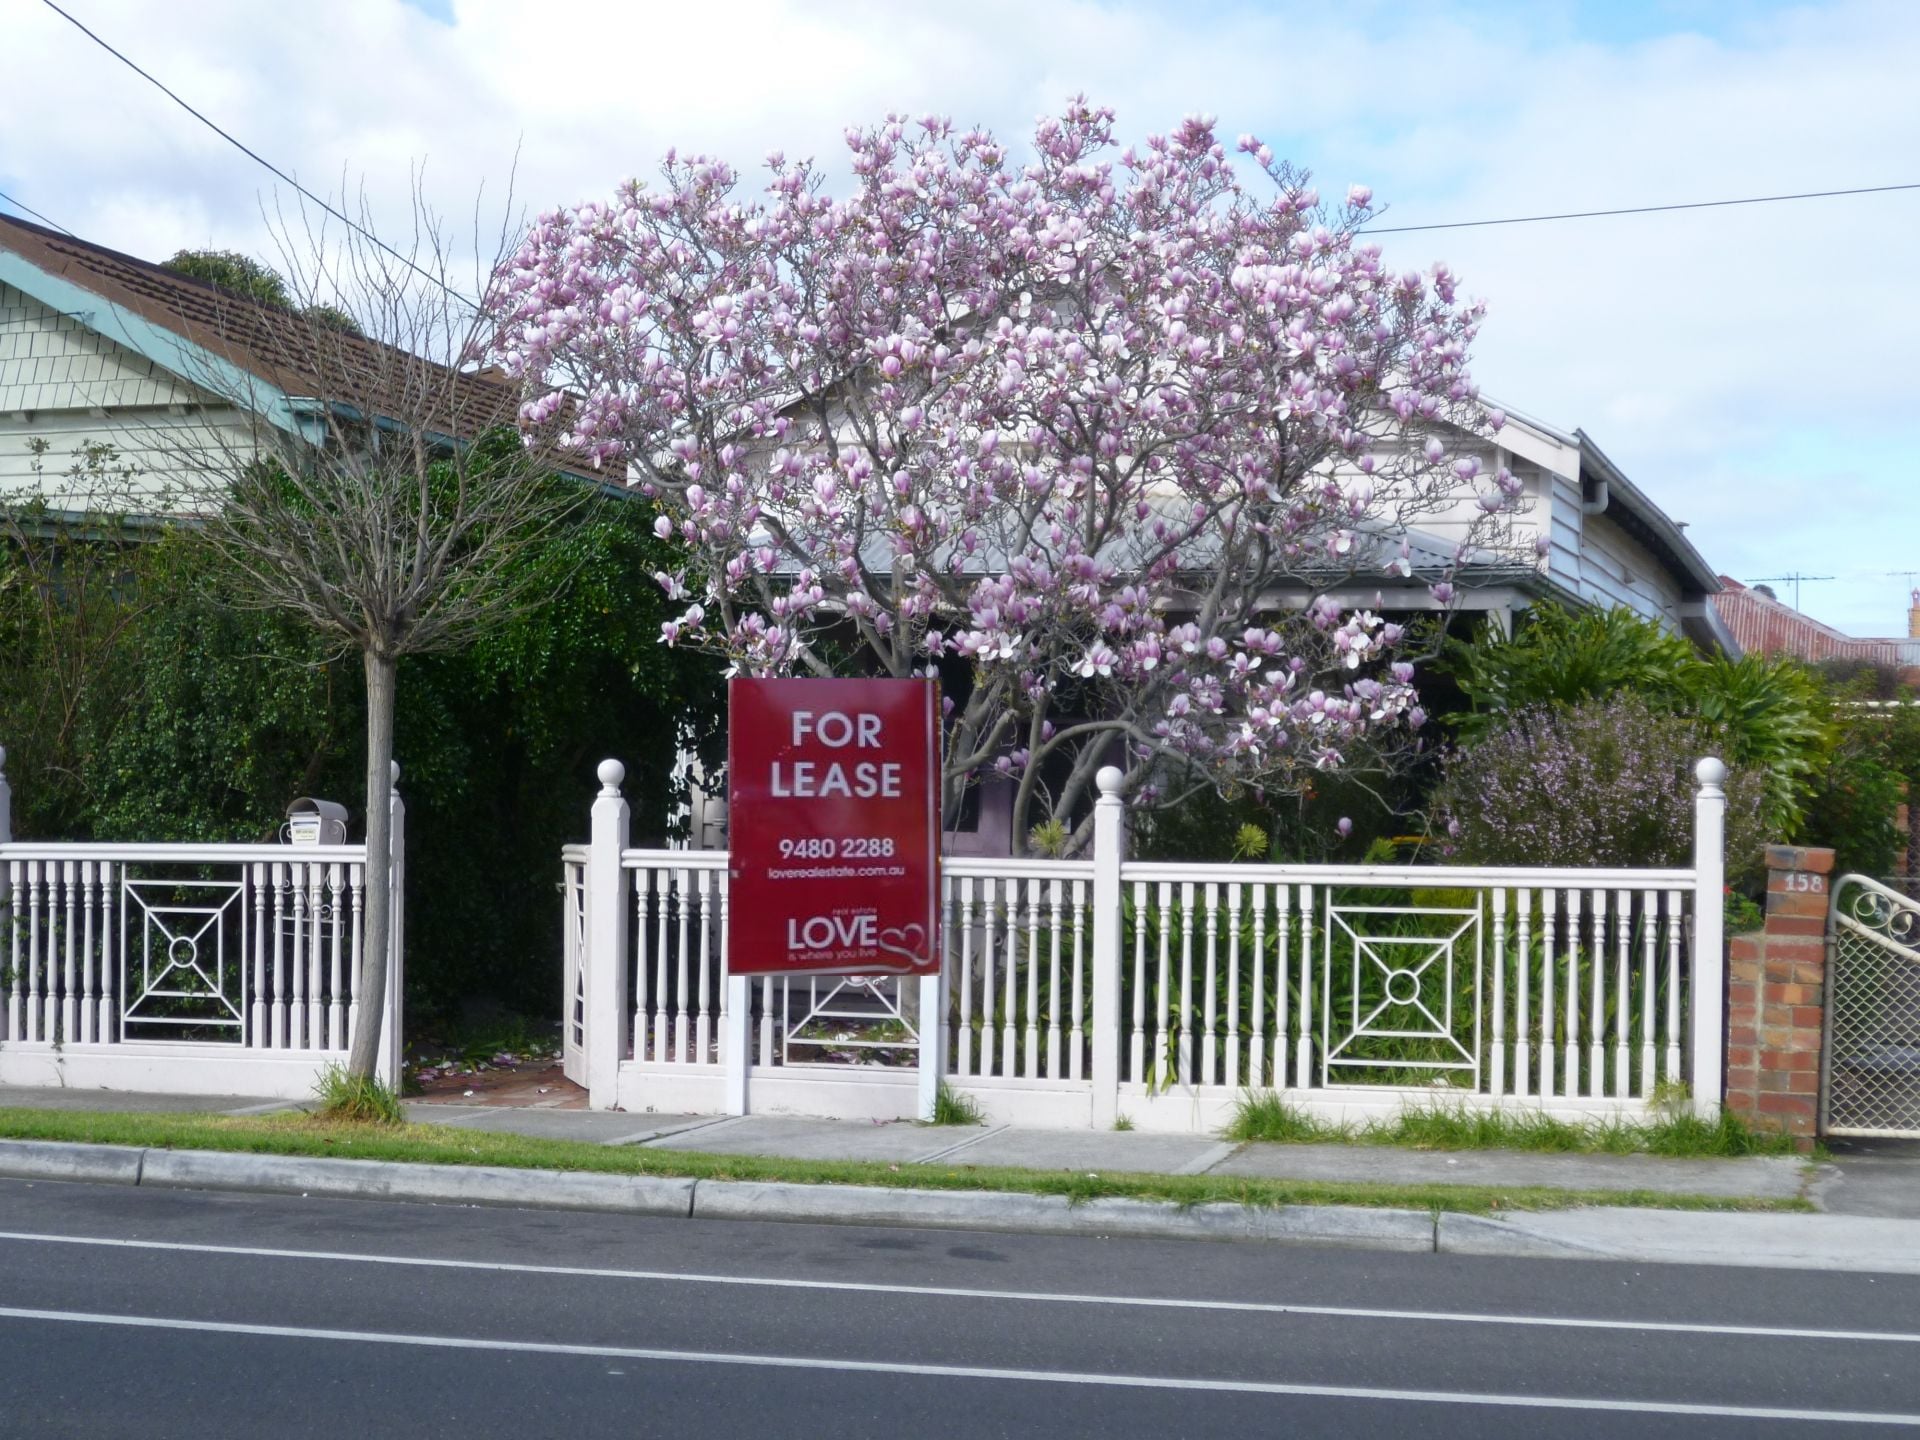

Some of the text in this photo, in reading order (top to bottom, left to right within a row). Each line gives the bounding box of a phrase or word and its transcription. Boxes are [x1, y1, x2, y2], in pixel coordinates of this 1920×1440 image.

[792, 711, 882, 748] FOR
[771, 761, 901, 798] LEASE
[779, 837, 894, 859] 9480 2288
[768, 865, 905, 880] loverealestate.com.au
[1784, 874, 1823, 893] 158
[788, 915, 877, 950] LOVE
[799, 950, 833, 960] where
[836, 951, 857, 960] you
[860, 948, 877, 957] live
